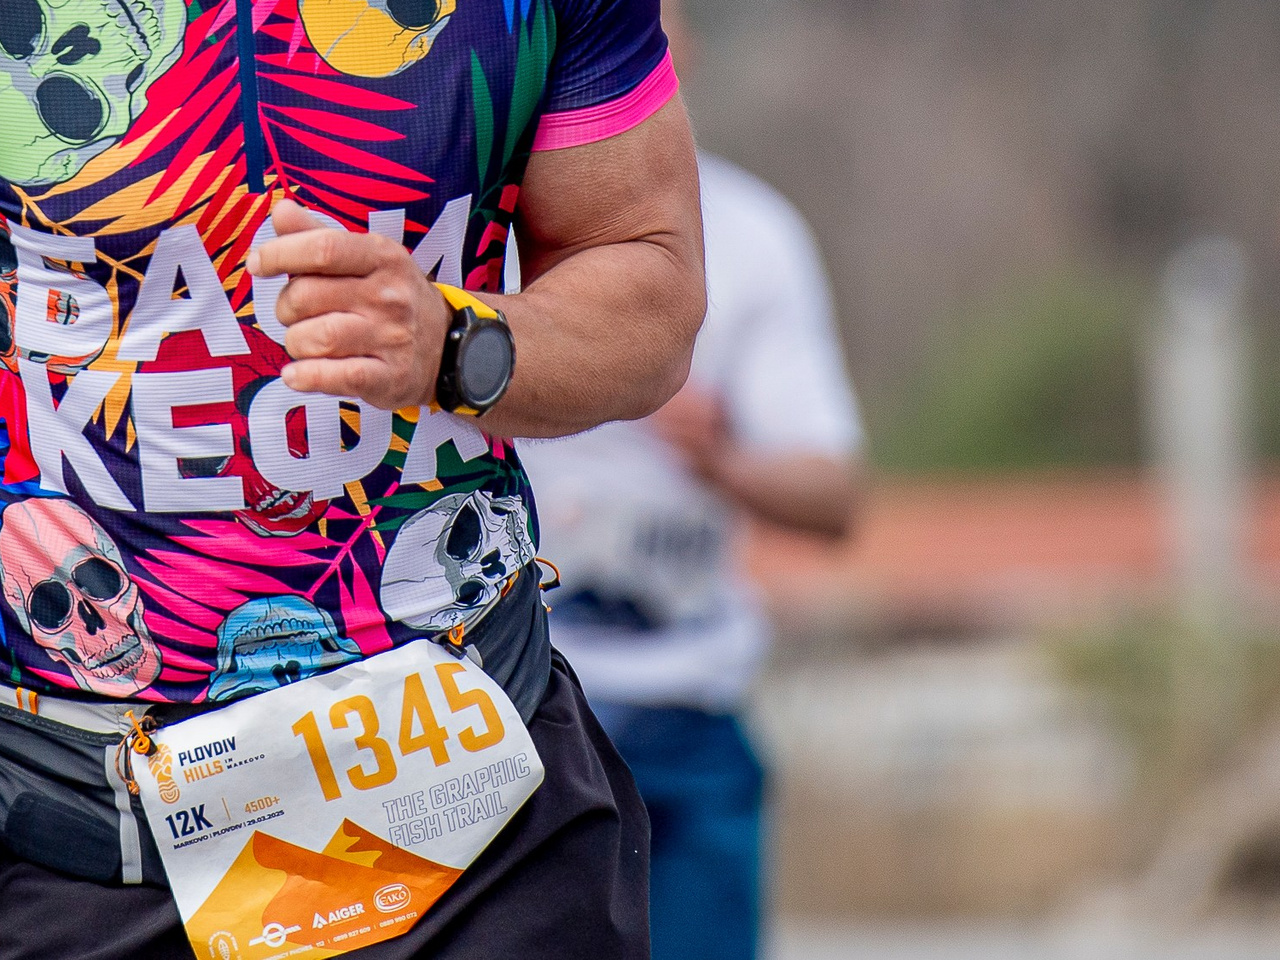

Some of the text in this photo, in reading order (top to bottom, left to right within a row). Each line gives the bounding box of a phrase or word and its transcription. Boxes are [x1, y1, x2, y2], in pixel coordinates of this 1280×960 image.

[291, 662, 505, 802] 1345
[178, 736, 236, 766] PLOVDIV
[226, 753, 266, 770] MARKOVO
[183, 759, 224, 784] HILLS
[382, 752, 531, 824] THE GRAPHIC
[165, 803, 213, 839] 12K
[173, 809, 285, 850] MARKOVO PLOVDIV 29.03.2025
[388, 791, 508, 850] FISH TRAIL
[328, 903, 366, 924] AIGER
